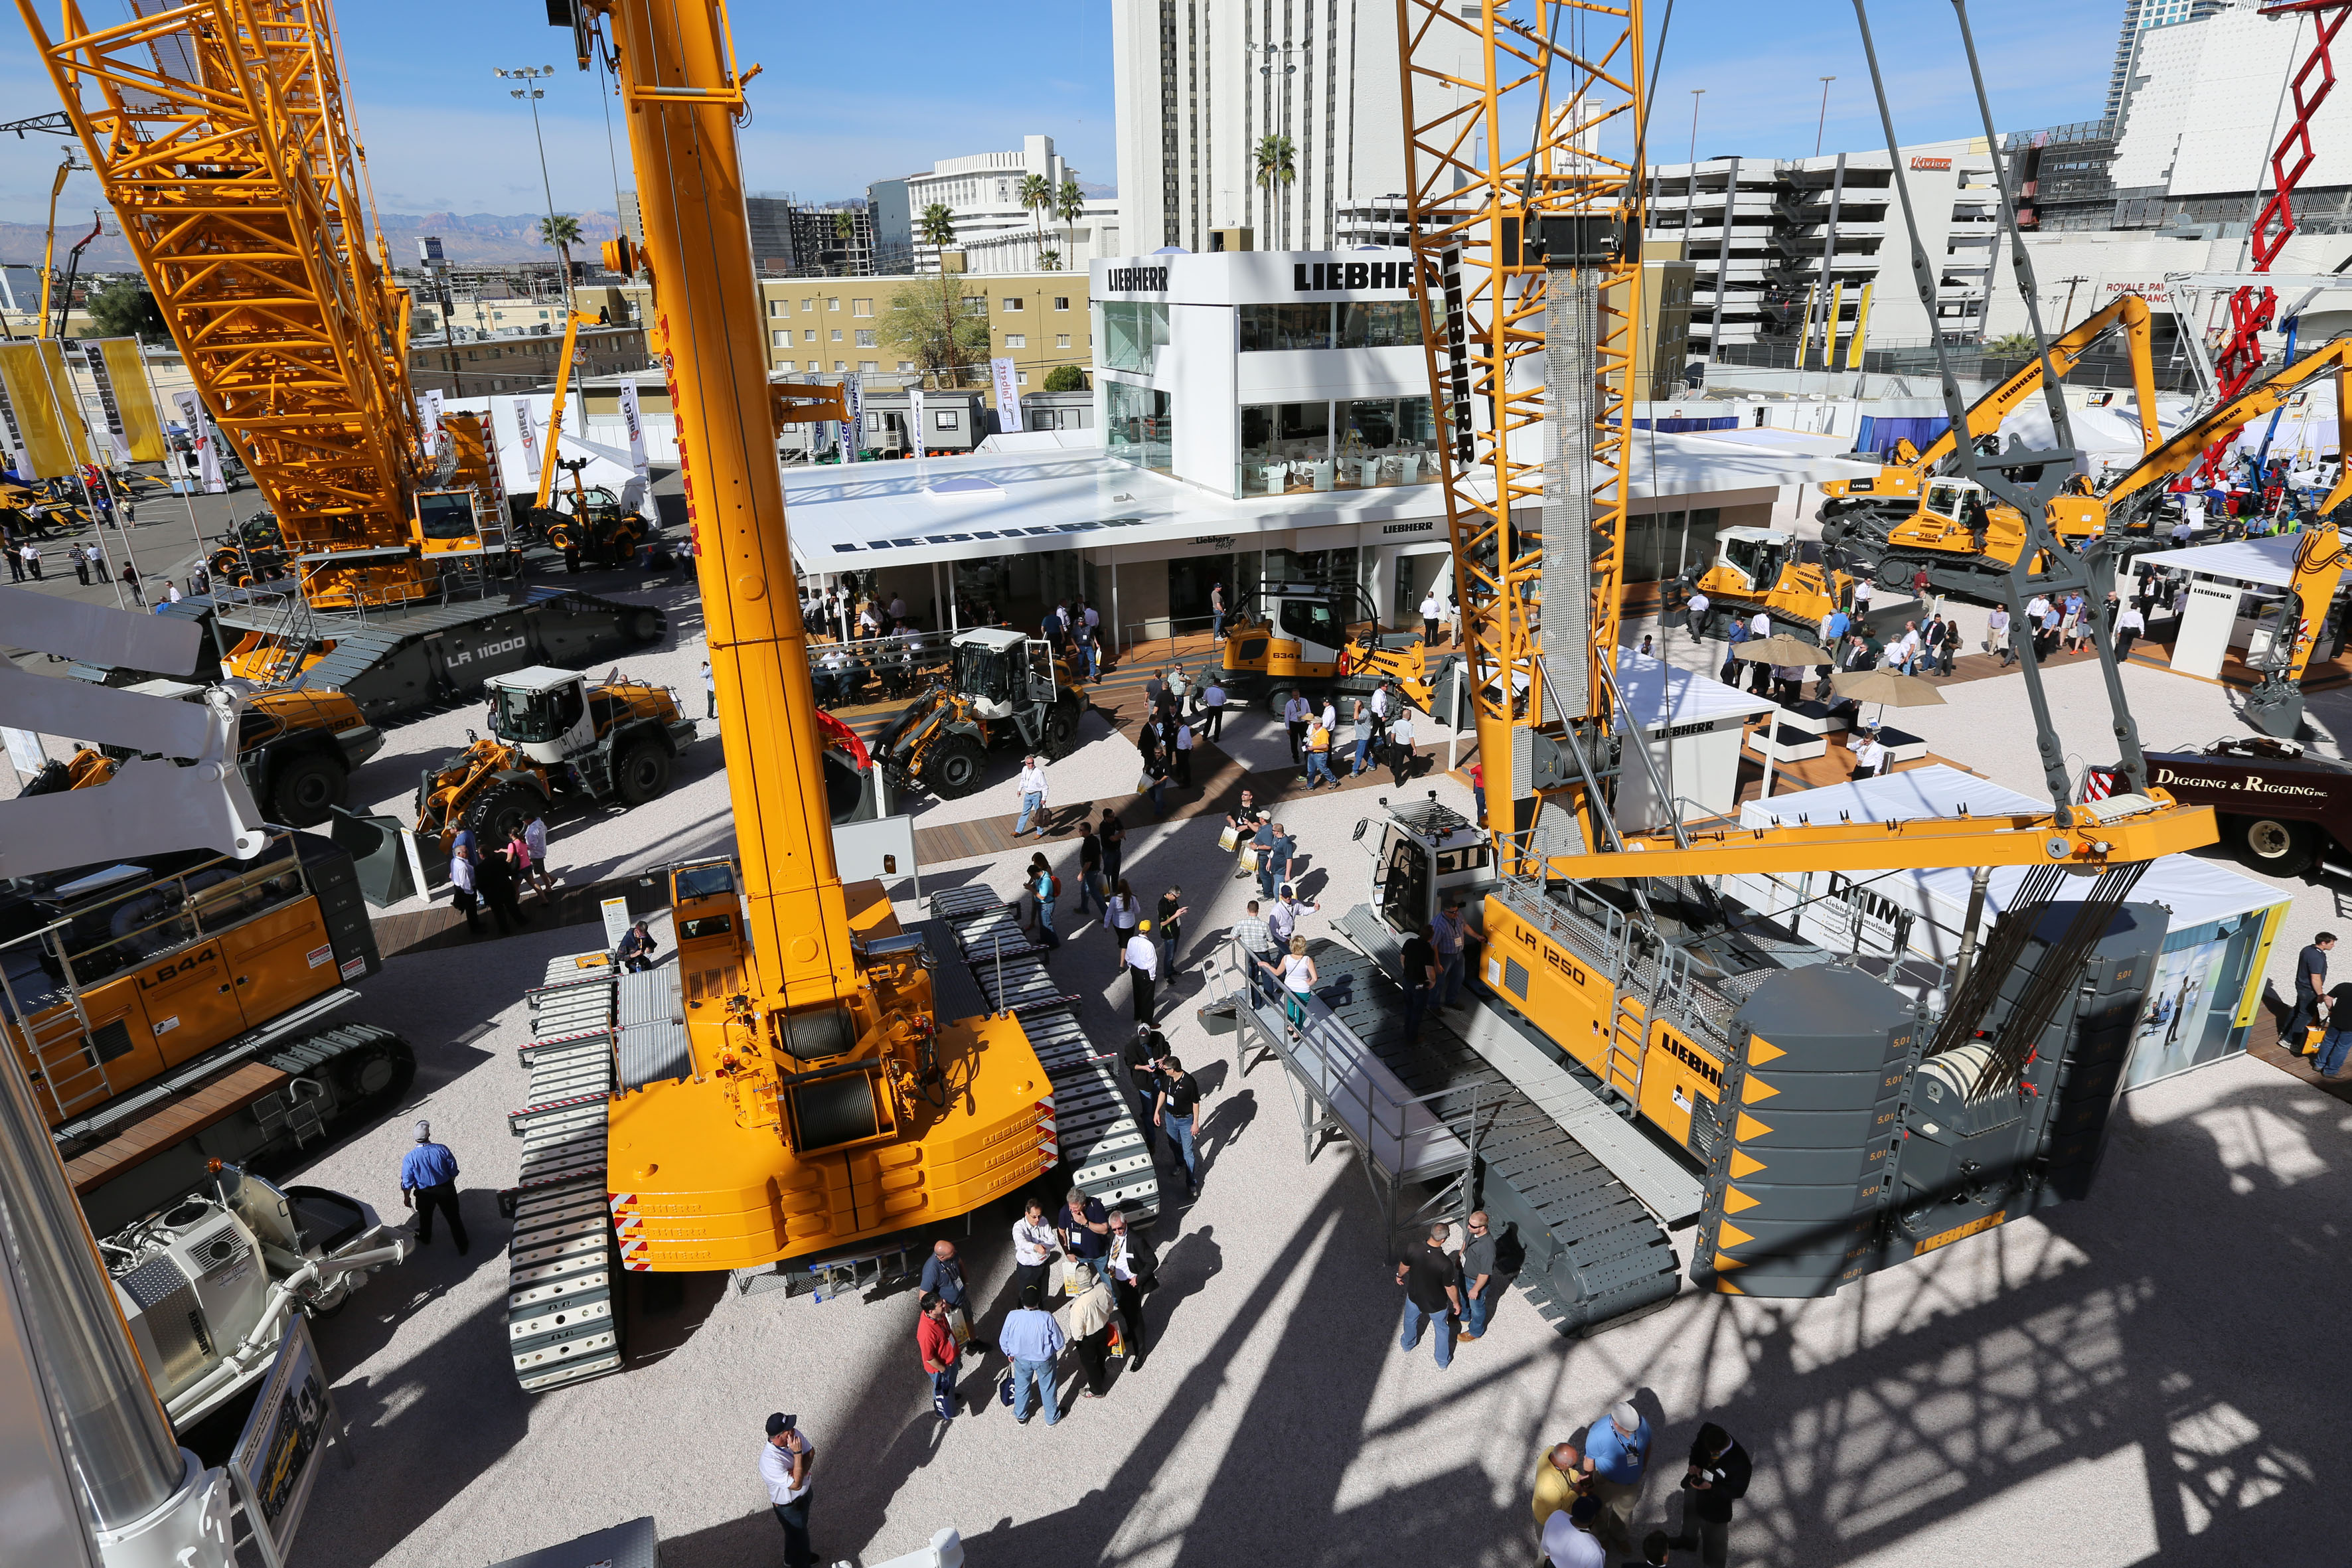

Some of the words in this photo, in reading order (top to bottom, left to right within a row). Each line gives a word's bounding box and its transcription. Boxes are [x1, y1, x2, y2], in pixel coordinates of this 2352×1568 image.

[1913, 156, 1951, 170] Riviera
[1107, 266, 1169, 291] LIEBHERR
[2106, 283, 2145, 292] ROYALE
[1443, 248, 1474, 465] LIEBHERR
[1997, 366, 2043, 404] LIEBHERR
[2088, 393, 2105, 404] CAT
[2290, 394, 2304, 404] CAT
[2198, 407, 2243, 438] LIEBHERR
[832, 518, 1151, 553] LIEBHERR
[1383, 521, 1433, 534] LIEBHERR
[2193, 588, 2232, 599] LIEBHERR
[447, 648, 472, 668] LR
[477, 635, 527, 660] 11000
[1655, 721, 1715, 740] LIEBHERR
[2156, 768, 2227, 789] DIGGING
[2231, 782, 2241, 791] &
[2242, 775, 2315, 797] RIGGING
[309, 947, 330, 959] DANGER
[343, 958, 362, 971] DANGER
[1516, 924, 1537, 951] LR
[1543, 945, 1586, 987] 1250
[140, 949, 217, 990] LB44
[1662, 1032, 1723, 1089] LIEBH
[982, 1108, 1046, 1146] LIEBHERR
[984, 1130, 1047, 1169] LIEBHERR
[986, 1152, 1049, 1191] LIEBHERR
[1914, 1210, 2006, 1257] LIEBHERR
[189, 1310, 211, 1356] LIEBHERR
